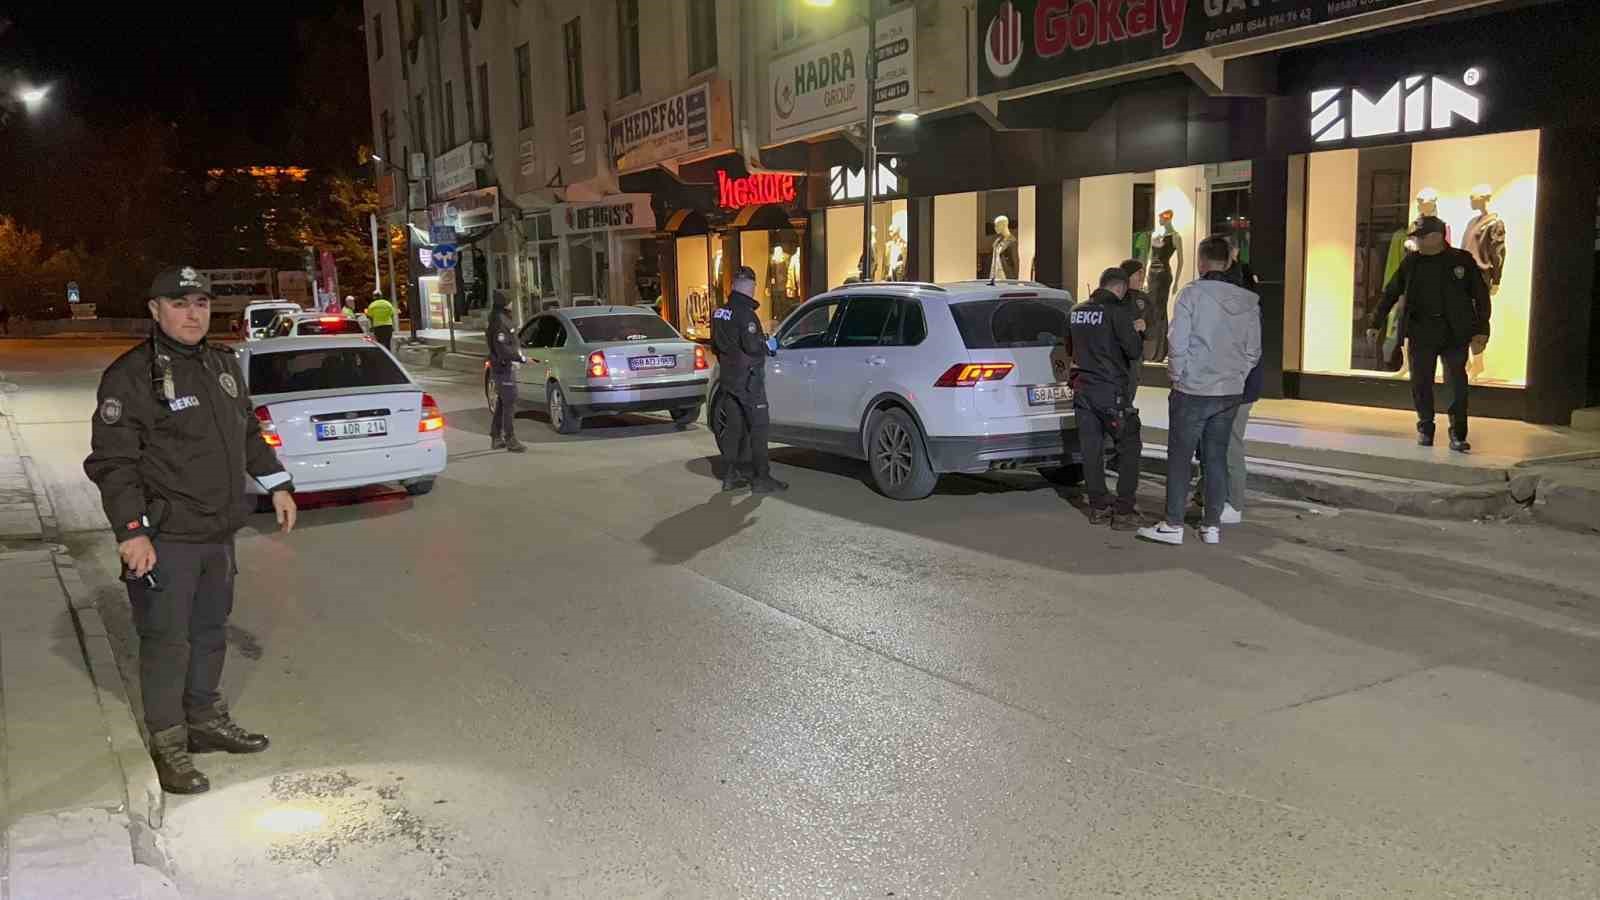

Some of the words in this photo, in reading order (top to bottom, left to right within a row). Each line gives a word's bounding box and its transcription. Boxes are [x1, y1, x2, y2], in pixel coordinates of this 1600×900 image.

[795, 48, 855, 96] HADRA
[823, 84, 856, 108] GROUP
[624, 96, 686, 144] HEDEF68
[323, 424, 337, 436] 68
[344, 422, 361, 434] ADR
[368, 420, 384, 432] 214
